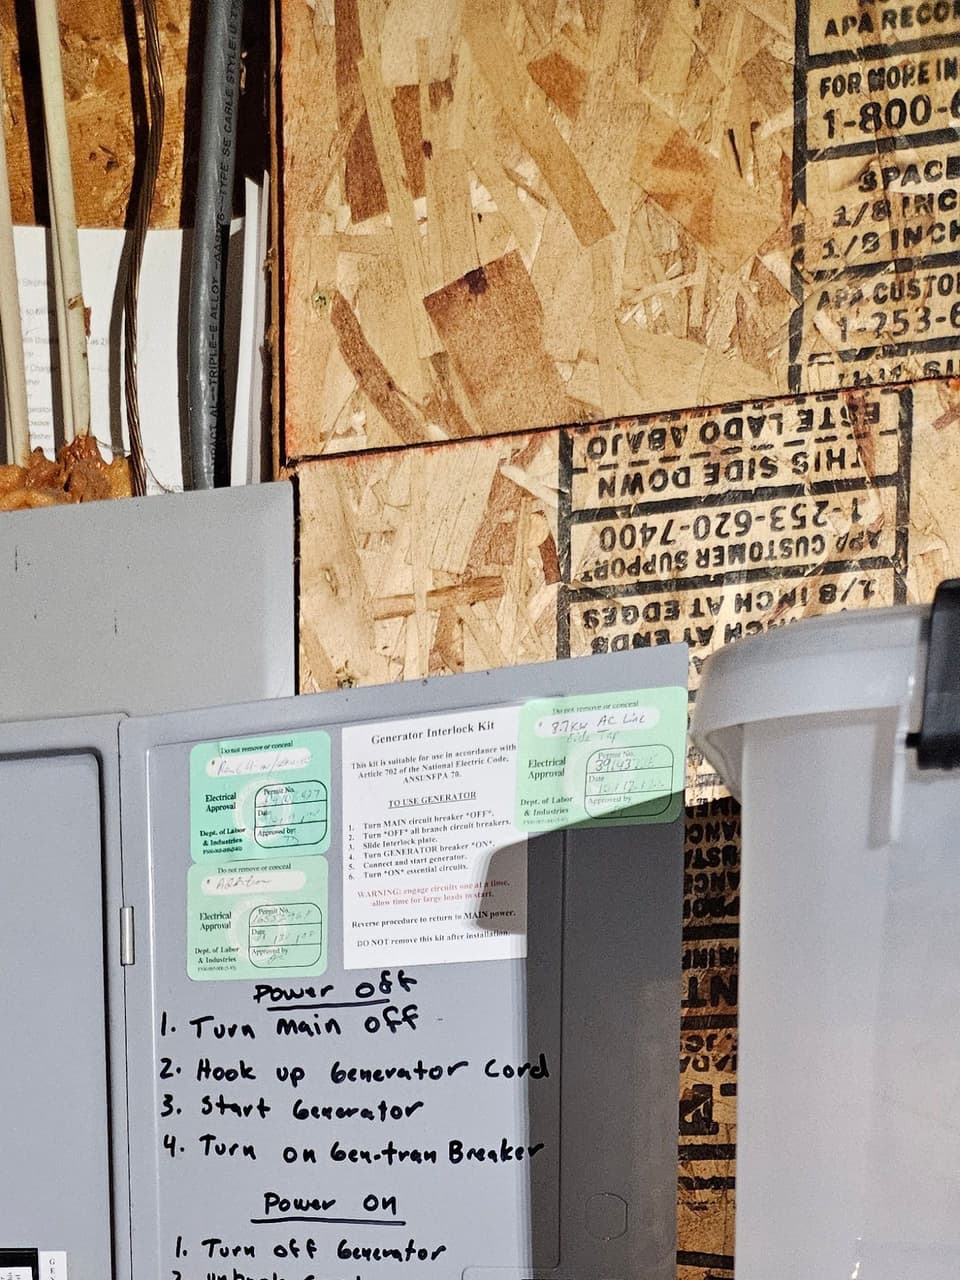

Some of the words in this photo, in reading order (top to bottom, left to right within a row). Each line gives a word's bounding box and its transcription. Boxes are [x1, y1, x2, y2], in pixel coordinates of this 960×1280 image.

[824, 12, 874, 38] APA
[819, 71, 862, 100] FOR
[832, 200, 891, 228] 1/8
[822, 231, 881, 260] 1/8
[586, 421, 687, 461] ABAJO
[699, 410, 786, 445] LADO
[703, 454, 779, 485] SIDE
[791, 447, 861, 476] THIS
[596, 465, 692, 500] DOWN
[599, 496, 863, 553] 1-253-620-7400
[695, 531, 827, 570] CUSTOMER
[581, 552, 687, 583] SUPPORT
[688, 592, 725, 619] AT
[734, 582, 809, 613] INCH
[582, 597, 682, 630] EDGES
[371, 726, 423, 746] Generator
[427, 721, 474, 738] Interlock
[478, 720, 495, 732] Kit
[205, 792, 237, 802] Electrical
[206, 802, 236, 813] Approval
[388, 799, 401, 809] TO
[402, 796, 419, 807] USE
[421, 791, 477, 805] GENERATOR
[464, 910, 488, 920] MAIN
[489, 909, 517, 919] power.
[253, 984, 334, 1004] Power
[160, 1011, 177, 1037] 1.
[189, 1015, 256, 1039] Turn
[276, 1013, 341, 1037] main
[364, 1004, 419, 1033] off
[159, 1058, 182, 1079] 2.
[196, 1057, 257, 1083] Hook
[276, 1065, 306, 1086] up
[330, 1059, 469, 1084] Generator
[484, 1053, 550, 1080] Cord
[160, 1094, 182, 1118] 3.
[201, 1094, 271, 1120] Start
[292, 1098, 425, 1121] Generator
[162, 1135, 185, 1157] 4.
[199, 1134, 257, 1161] Turn
[282, 1145, 317, 1164] on
[447, 1137, 545, 1164] Breaker
[263, 1191, 337, 1215] Power
[175, 1236, 188, 1258] 1.
[201, 1238, 256, 1259] Turn
[273, 1238, 317, 1259] off
[336, 1238, 447, 1262] Generator
